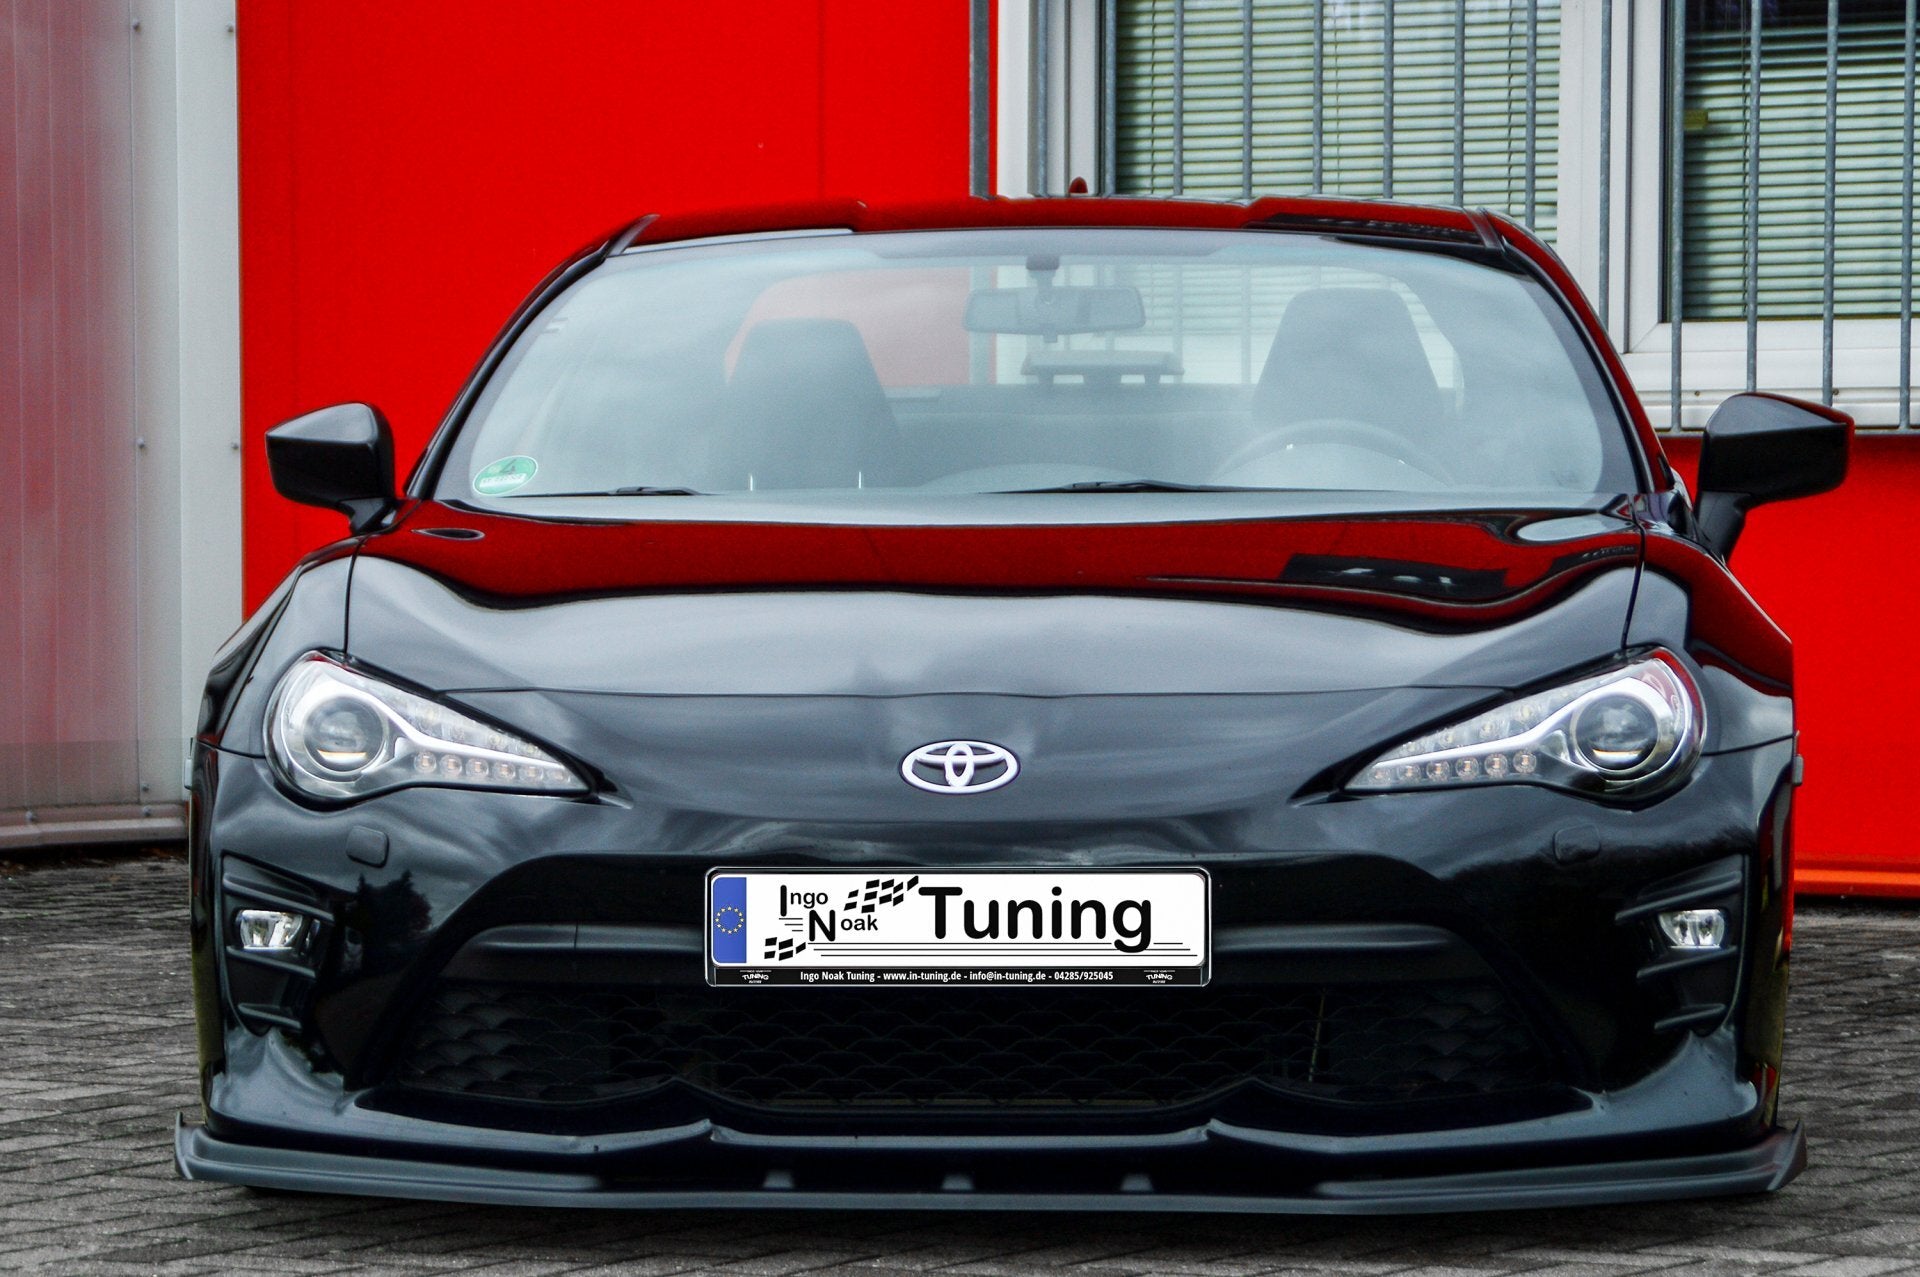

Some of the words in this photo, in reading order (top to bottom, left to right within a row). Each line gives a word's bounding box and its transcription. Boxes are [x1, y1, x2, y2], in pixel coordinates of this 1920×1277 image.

[780, 884, 829, 917] Ingo
[808, 909, 879, 942] Noak
[918, 885, 1152, 953] Tuning
[800, 971, 819, 983] Ingo
[821, 971, 845, 981] Noak
[846, 971, 876, 983] Tuning
[883, 971, 962, 983] www.in-tuning.de
[969, 971, 1047, 983] info@in-tuning.de
[1054, 971, 1114, 981] 04285/925045
